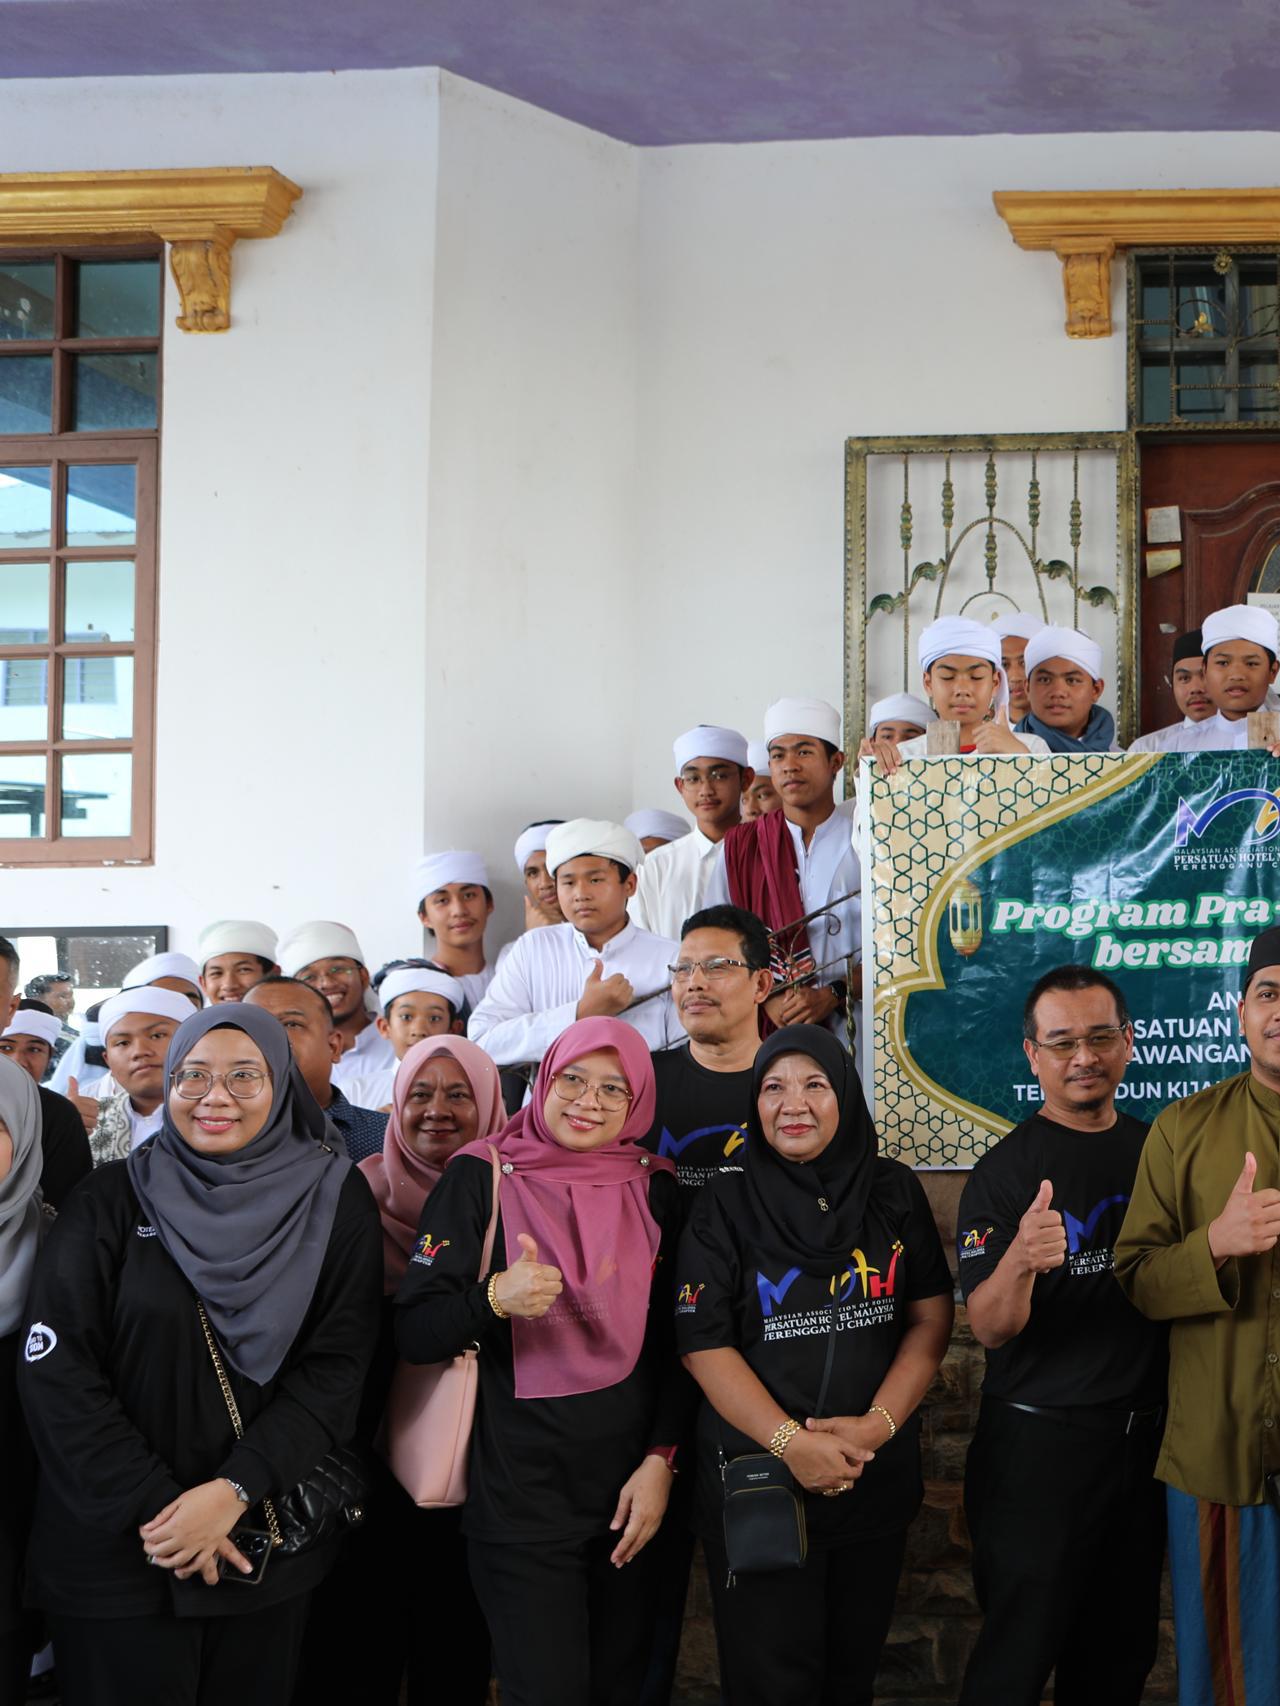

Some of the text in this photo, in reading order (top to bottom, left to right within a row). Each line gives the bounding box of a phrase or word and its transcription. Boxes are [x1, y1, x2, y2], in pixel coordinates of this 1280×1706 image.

[1174, 852, 1237, 864] PERSATUAN
[1239, 852, 1275, 863] HOTEL
[1175, 847, 1221, 855] MALAYSIAN
[1174, 862, 1263, 870] TERENGGANU
[991, 898, 1187, 936] Program
[1095, 935, 1252, 968] bersam
[1131, 1017, 1231, 1040] SATUAN
[1126, 1044, 1251, 1065] AWANGAN
[1115, 1082, 1163, 1100] DUN
